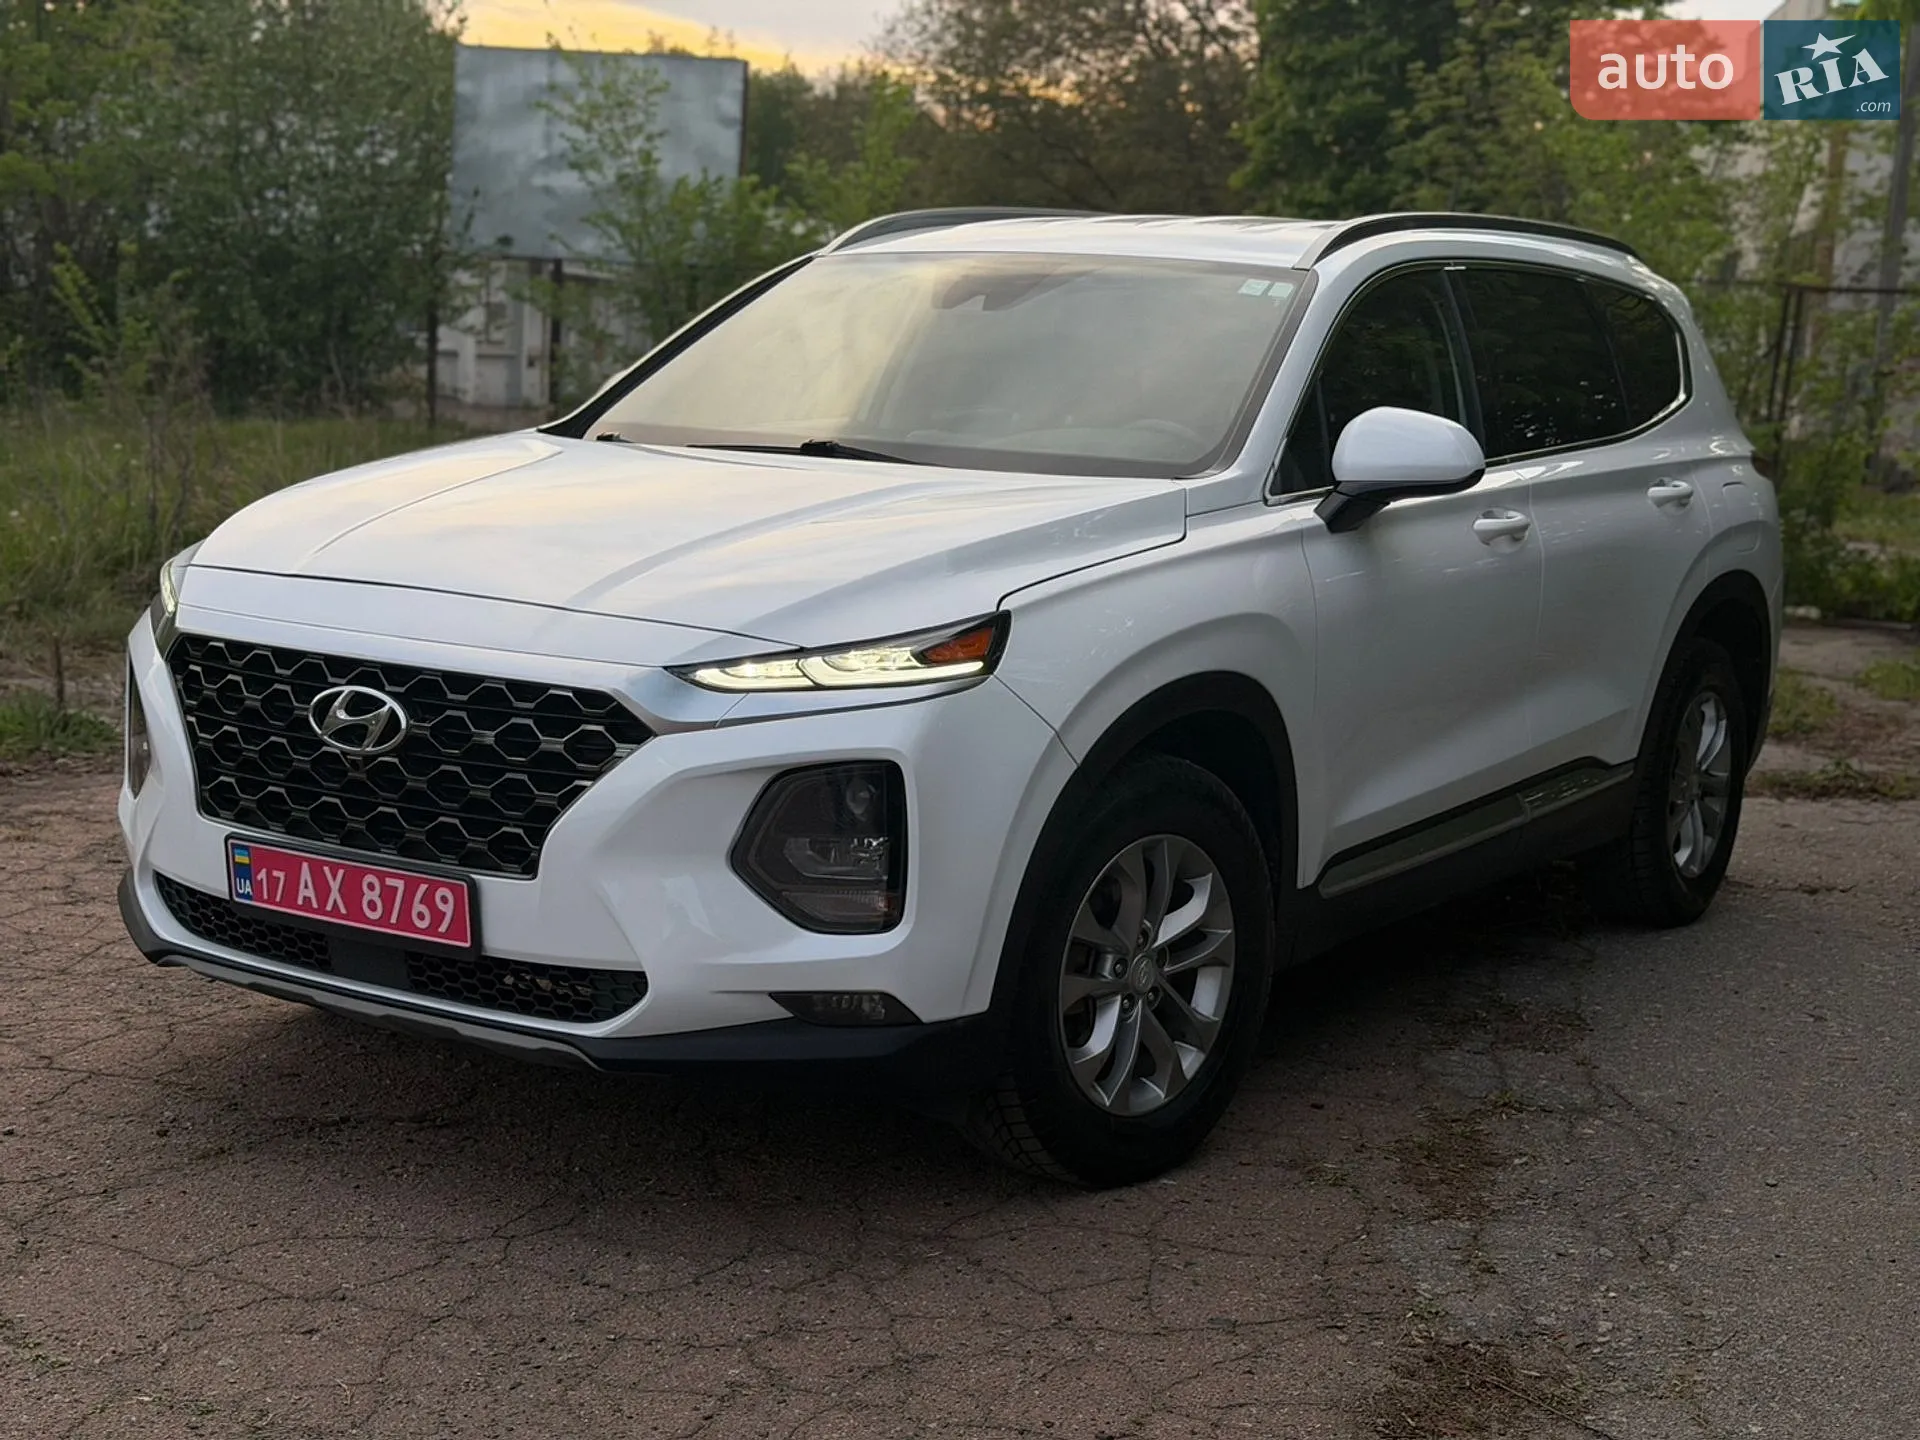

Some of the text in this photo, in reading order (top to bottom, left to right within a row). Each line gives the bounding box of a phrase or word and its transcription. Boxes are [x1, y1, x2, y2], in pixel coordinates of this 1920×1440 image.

[236, 876, 252, 896] UA
[257, 861, 455, 933] 17 AX 8769
